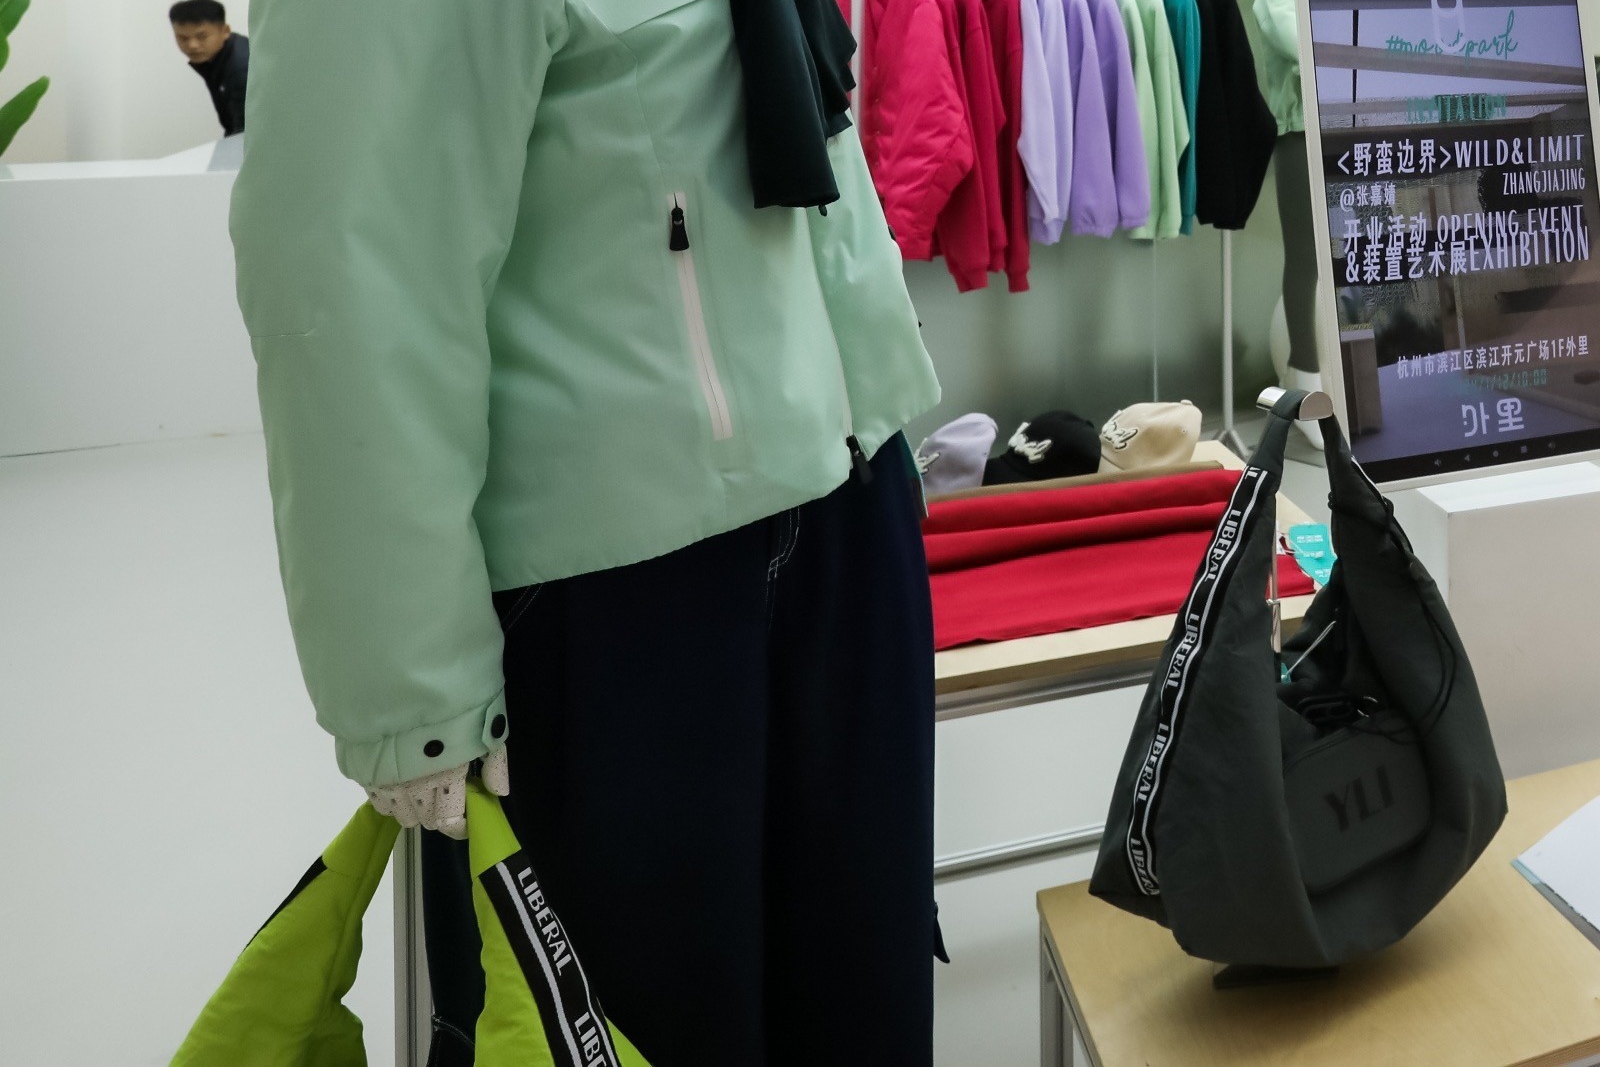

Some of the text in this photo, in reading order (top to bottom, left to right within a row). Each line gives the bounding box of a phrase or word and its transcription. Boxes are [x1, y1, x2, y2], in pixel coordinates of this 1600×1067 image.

[1503, 168, 1586, 195] ZHANGJIAJING
[1344, 205, 1584, 254] 开业活动 OPENING EVENT
[1205, 509, 1242, 583] LIBERAL
[1165, 613, 1200, 690] LIBERAL
[1136, 722, 1170, 803] LIBERAL
[517, 866, 573, 976] LIBERAL
